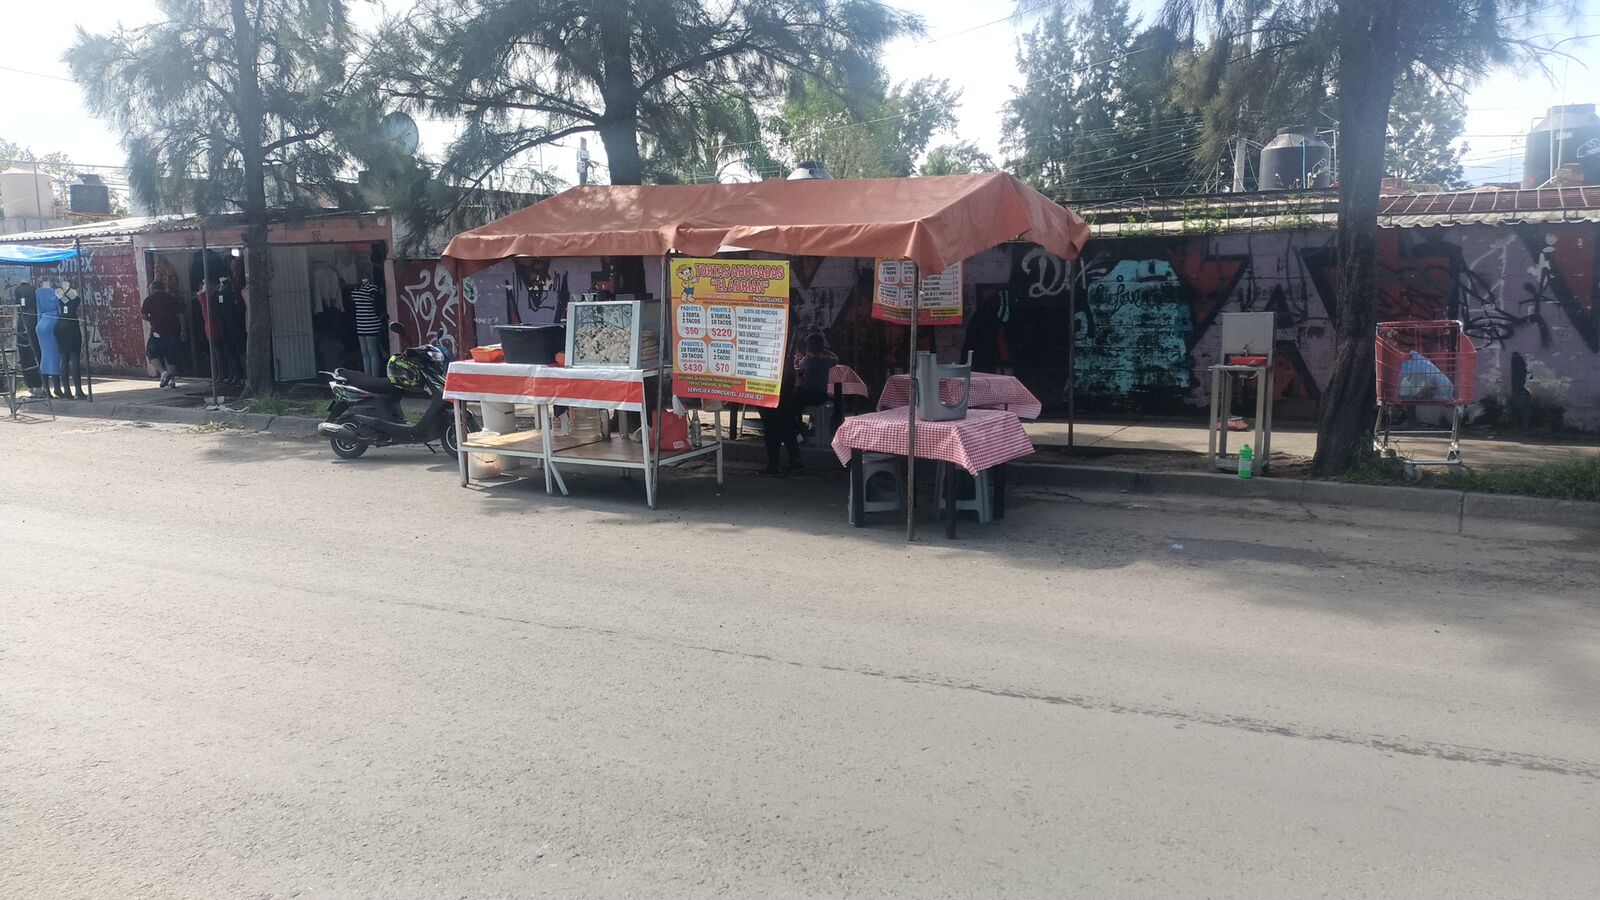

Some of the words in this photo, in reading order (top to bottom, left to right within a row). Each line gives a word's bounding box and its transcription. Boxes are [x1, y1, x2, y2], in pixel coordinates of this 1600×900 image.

[694, 263, 730, 277] TORTAS
[731, 264, 785, 280] AHOGADAS
[685, 327, 699, 335] $50
[711, 328, 732, 337] $220
[683, 363, 703, 372] $430
[715, 362, 730, 372] $70
